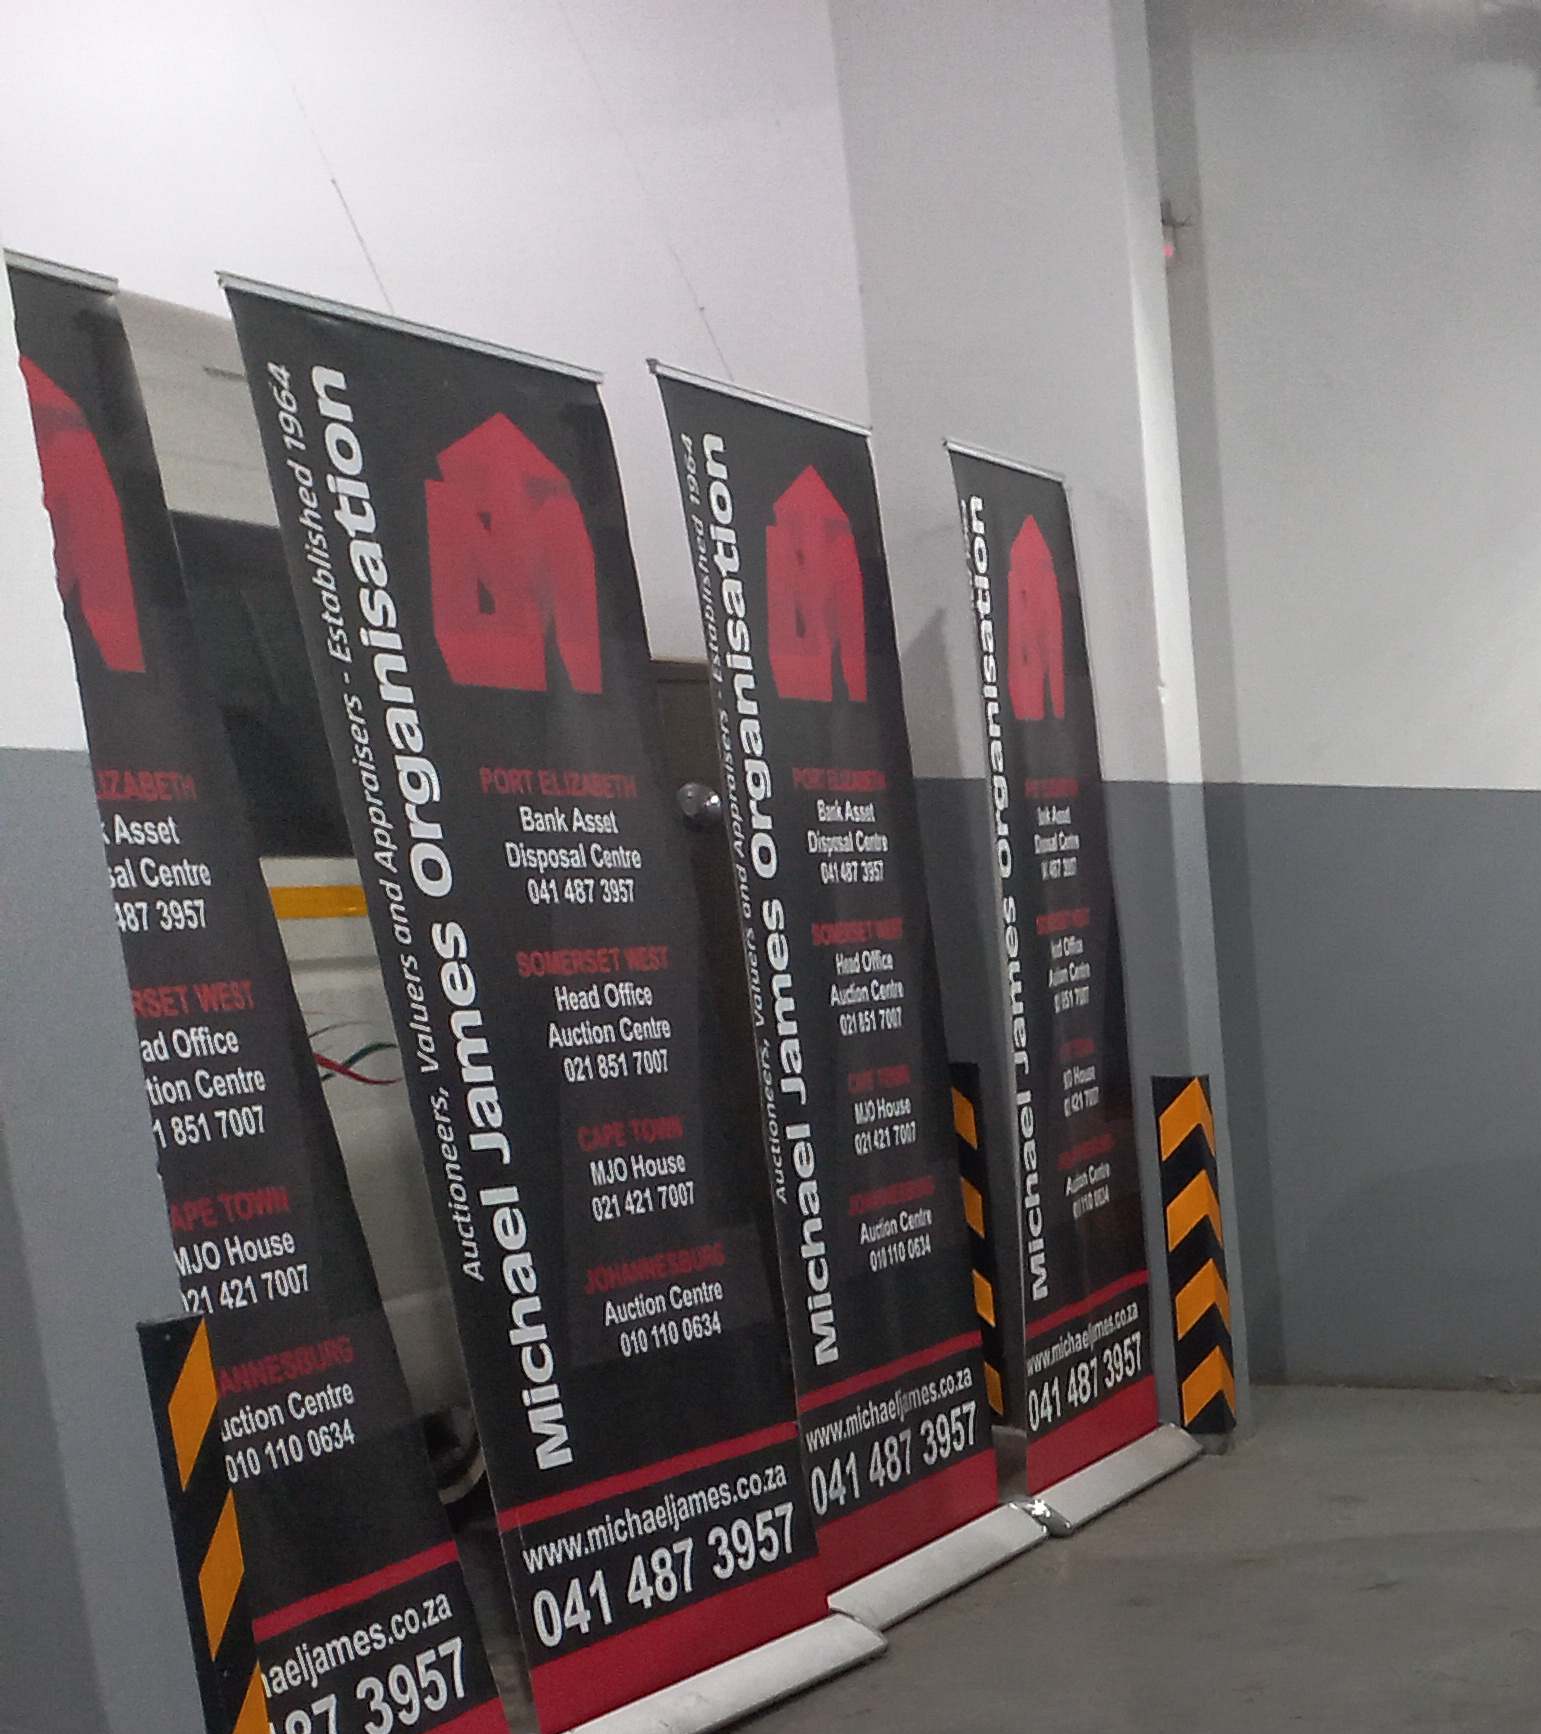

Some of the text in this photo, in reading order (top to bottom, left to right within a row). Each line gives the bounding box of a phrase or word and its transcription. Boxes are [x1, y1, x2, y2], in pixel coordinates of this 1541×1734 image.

[267, 361, 307, 451] 1964
[286, 459, 352, 663] Established
[97, 767, 197, 801] IZABETH
[343, 693, 398, 875] Appraisers
[480, 767, 638, 798] PORT ELIZABETH
[113, 813, 180, 845] Asset
[519, 806, 619, 834] Bank Asset
[139, 857, 212, 888] Centre
[504, 842, 642, 874] Disposal Centre
[379, 879, 412, 945] and
[527, 878, 635, 904] 041 487 3957
[703, 433, 839, 1366] Michael James Organisation
[156, 899, 207, 932] 3957
[311, 365, 573, 1471] Michael James Organisation
[193, 980, 256, 1013] WEST
[554, 982, 653, 1012] Head Office
[1003, 896, 1029, 1075] James
[400, 953, 440, 1074] Valuers
[549, 1016, 671, 1049] Auction Centre
[172, 1026, 240, 1059] Office
[194, 1067, 266, 1099] Centre
[563, 1049, 669, 1083] 021 851 7007
[171, 1112, 212, 1147] 851
[214, 1104, 265, 1139] 7007
[430, 1085, 485, 1282] Auctioneers,
[590, 1154, 686, 1186] MJO House
[219, 1186, 290, 1223] TOWN
[592, 1181, 695, 1222] 021 421 7007
[1016, 1090, 1048, 1300] Michael
[174, 1231, 296, 1276] MJO House
[219, 1275, 259, 1310] 421
[261, 1264, 310, 1301] 7007
[605, 1281, 724, 1327] Auction Centre
[620, 1311, 722, 1358] 010 110 0634
[287, 1383, 355, 1422] Centre
[1029, 1331, 1141, 1431] 041 487 3957
[805, 1367, 973, 1453] www.michaeljames.co.za
[225, 1418, 356, 1485] 010 110 0634
[811, 1400, 976, 1515] 041 487 3957
[522, 1464, 788, 1575] www.michaeljames.co.za
[533, 1501, 795, 1648] 041 487 3957
